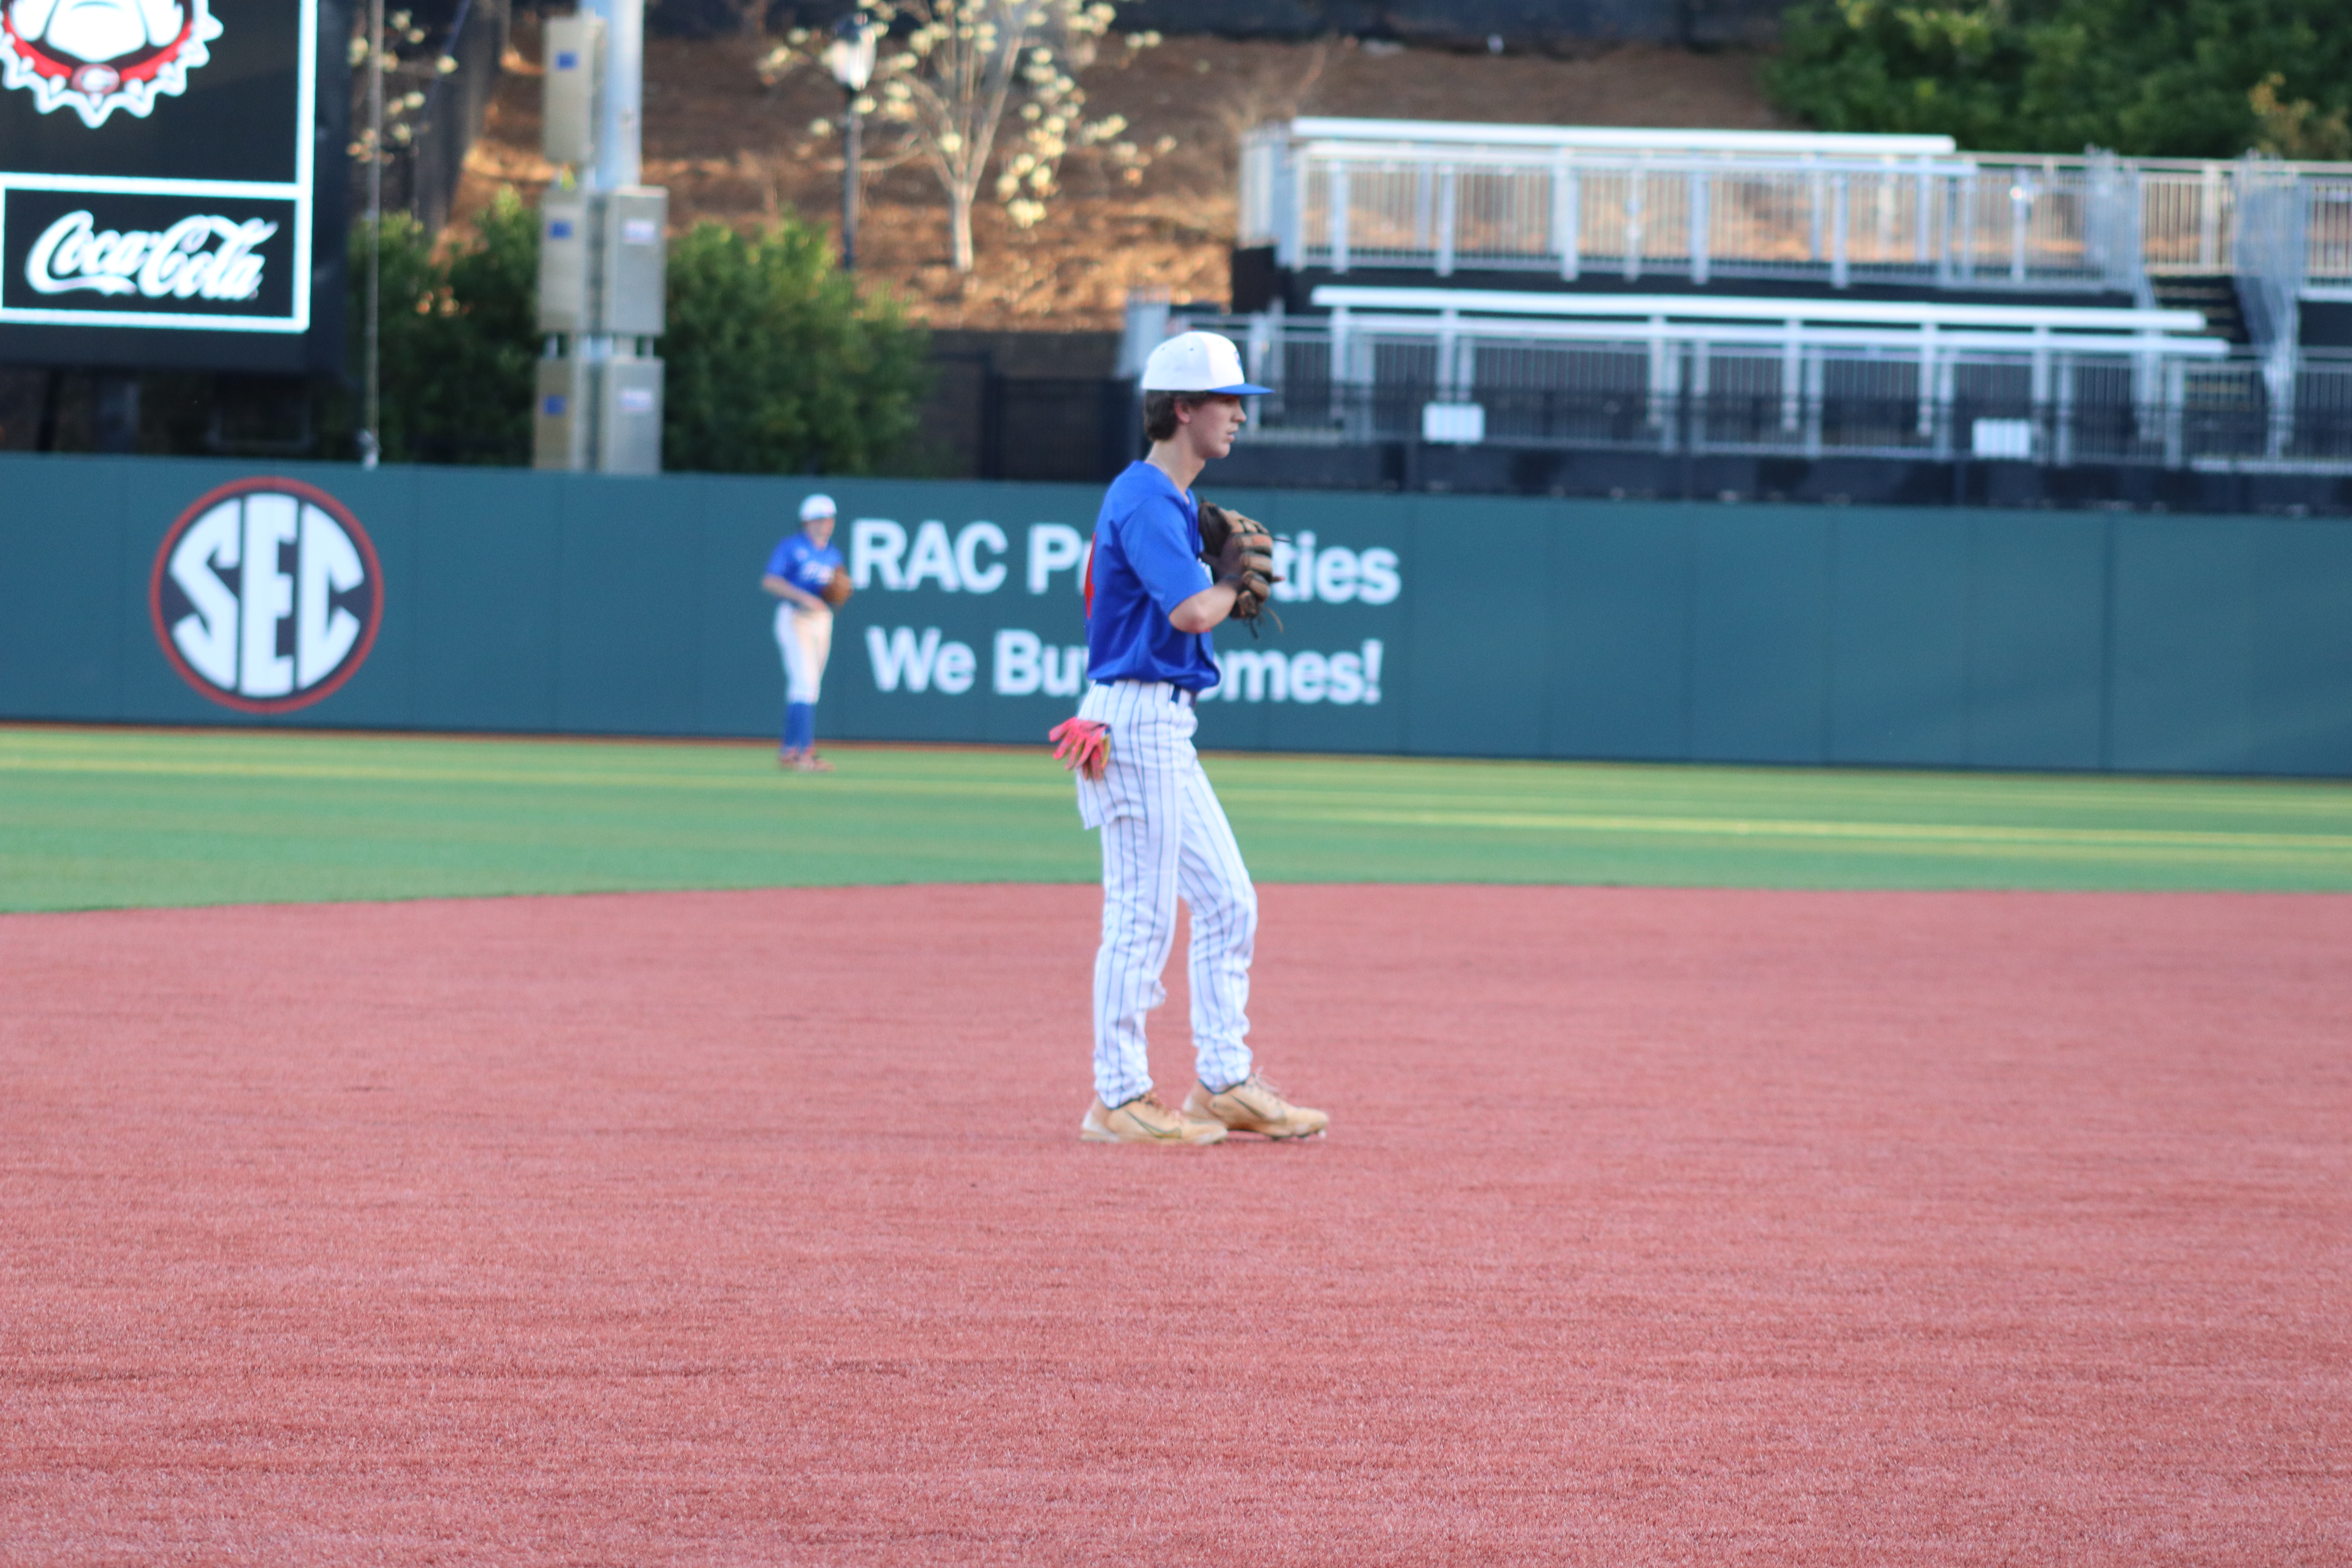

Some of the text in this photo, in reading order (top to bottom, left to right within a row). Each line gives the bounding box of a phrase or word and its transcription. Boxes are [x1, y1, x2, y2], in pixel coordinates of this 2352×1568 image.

[26, 211, 278, 299] Coca-Cola
[171, 494, 363, 696] SEC
[851, 519, 1007, 593] RAC
[1028, 524, 1401, 604] Pties
[867, 626, 976, 693] We
[1196, 640, 1382, 704] mes!
